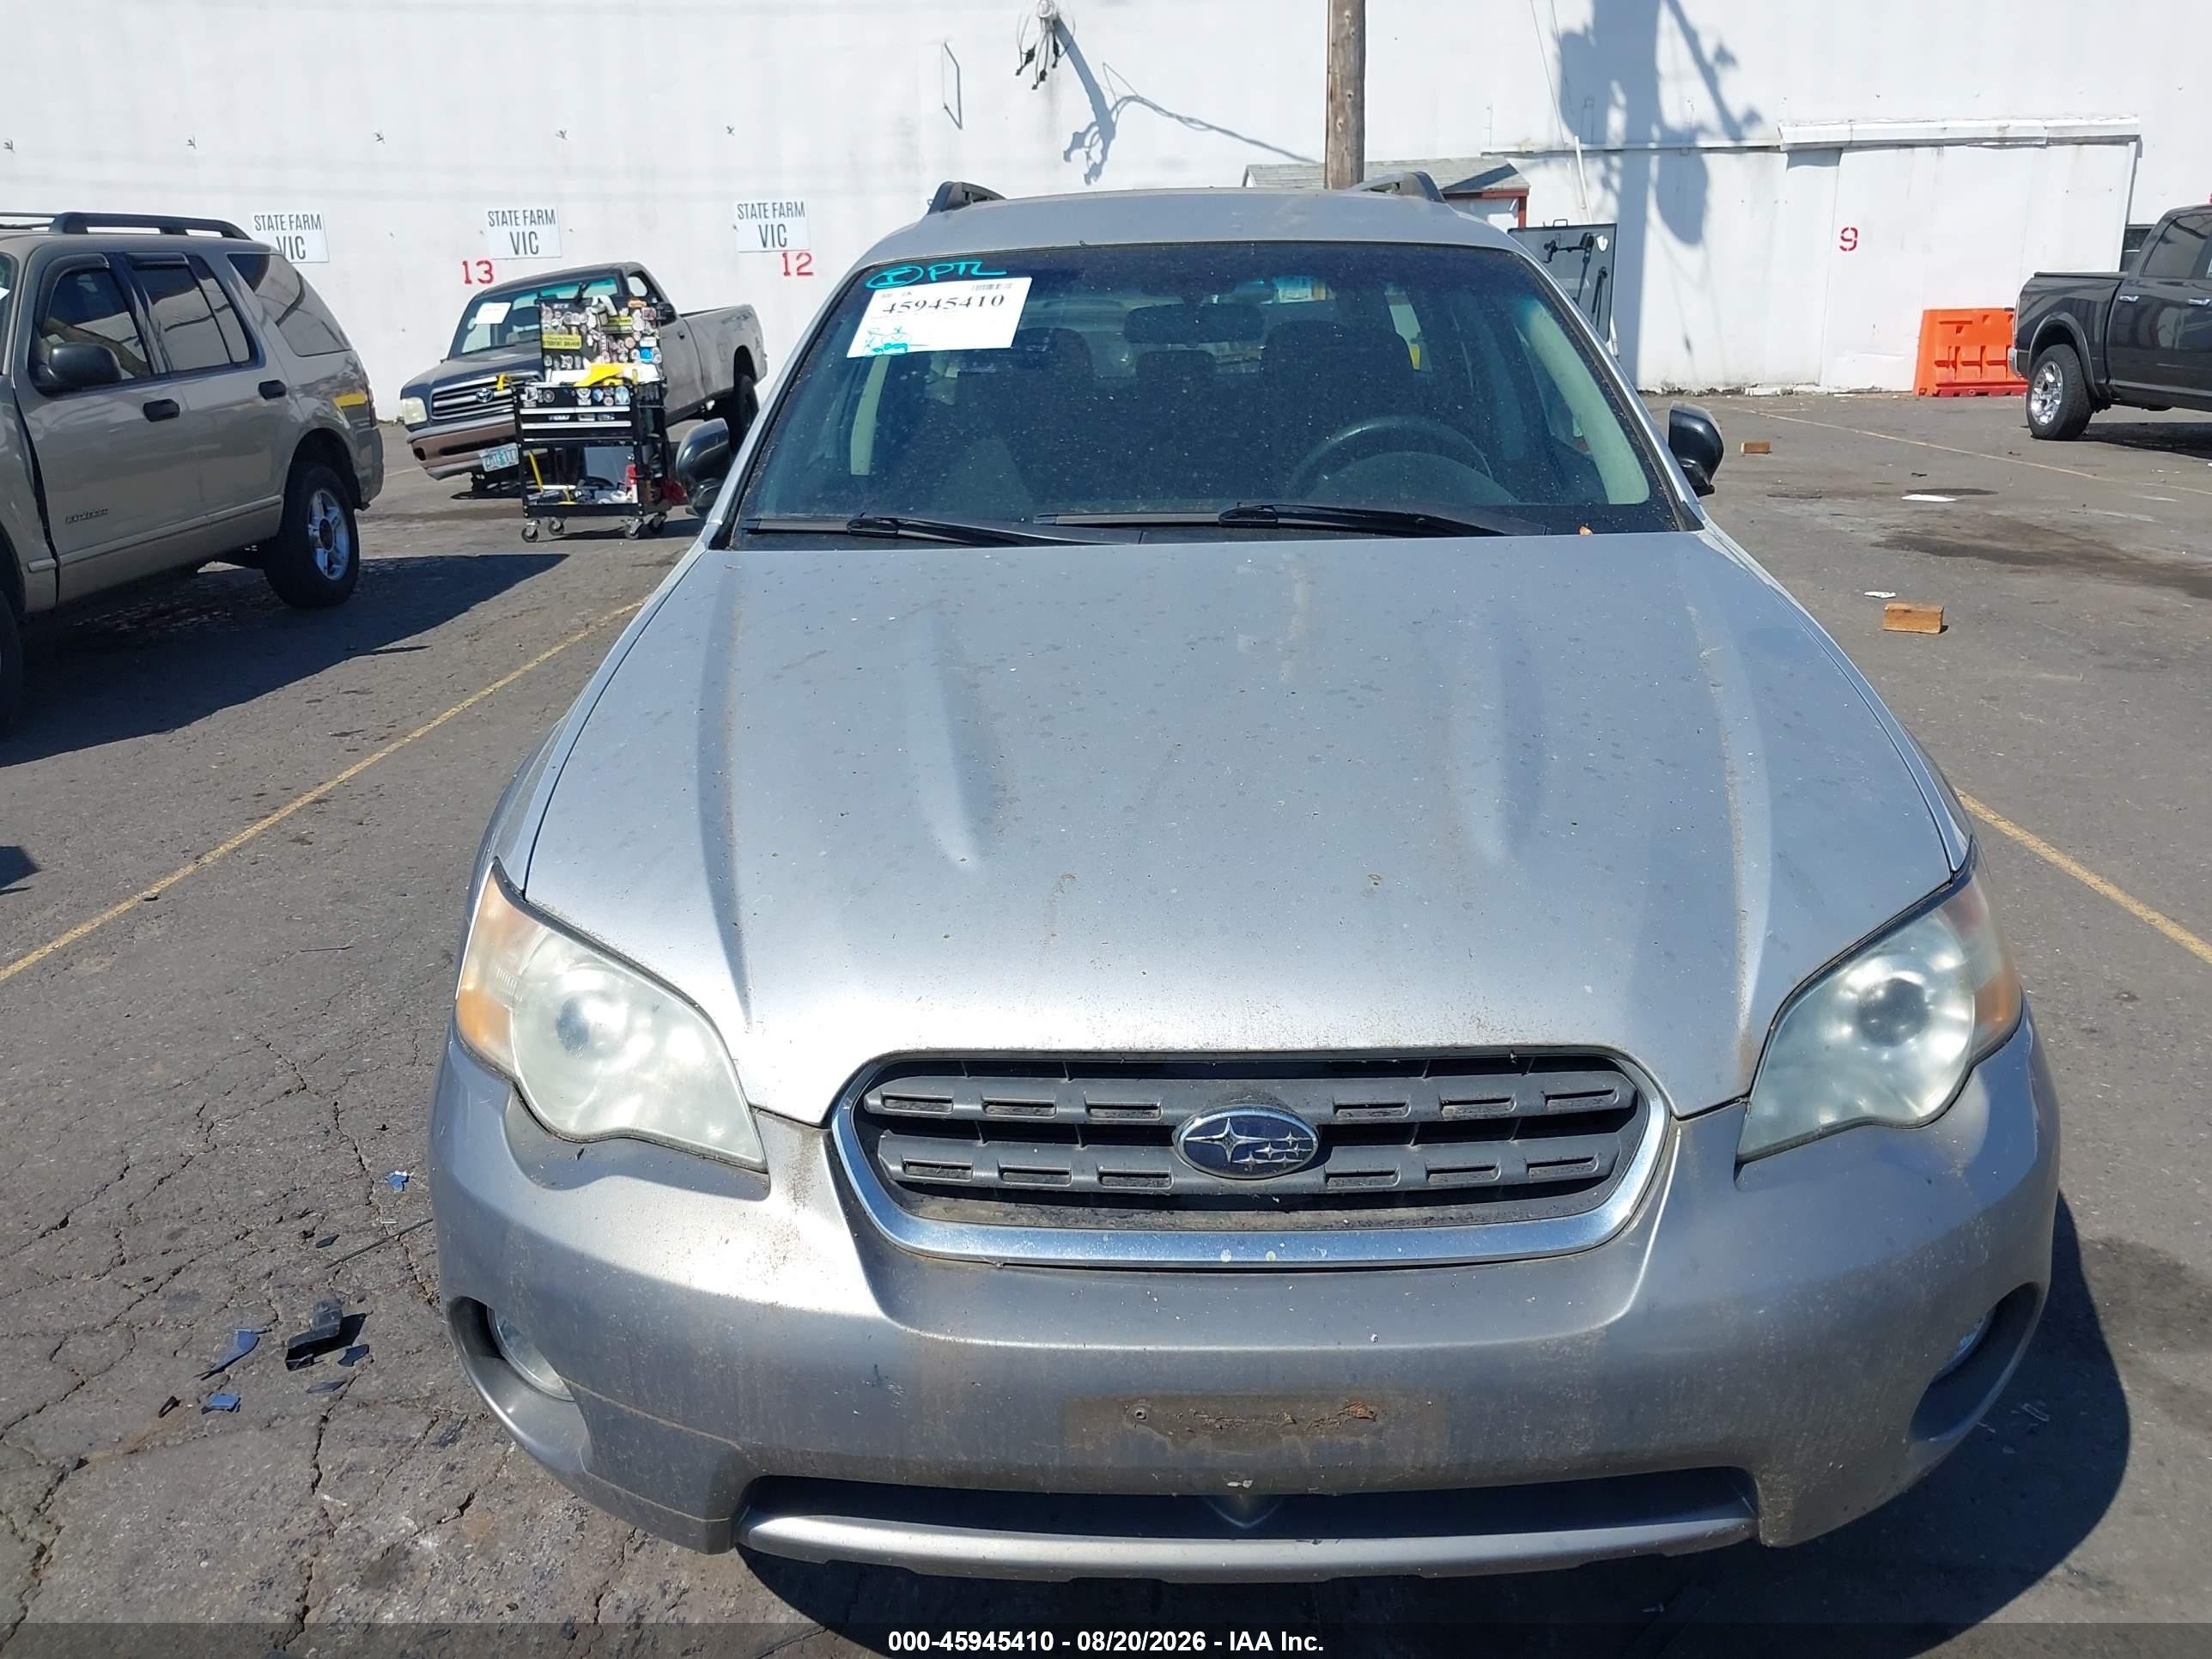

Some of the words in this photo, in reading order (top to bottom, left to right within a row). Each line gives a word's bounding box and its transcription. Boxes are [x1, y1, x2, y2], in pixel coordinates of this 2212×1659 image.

[253, 214, 287, 231] STATE
[289, 213, 322, 231] FARM
[487, 210, 520, 227] STATE
[522, 209, 556, 226] FARM
[737, 203, 769, 220] STATE
[771, 201, 806, 218] FARM
[276, 235, 306, 260] VIC
[509, 230, 539, 255] VIC
[758, 223, 787, 248] VIC
[1839, 227, 1858, 252] 9
[462, 260, 494, 284] 13
[782, 252, 814, 276] 12
[882, 294, 1005, 314] 45945410
